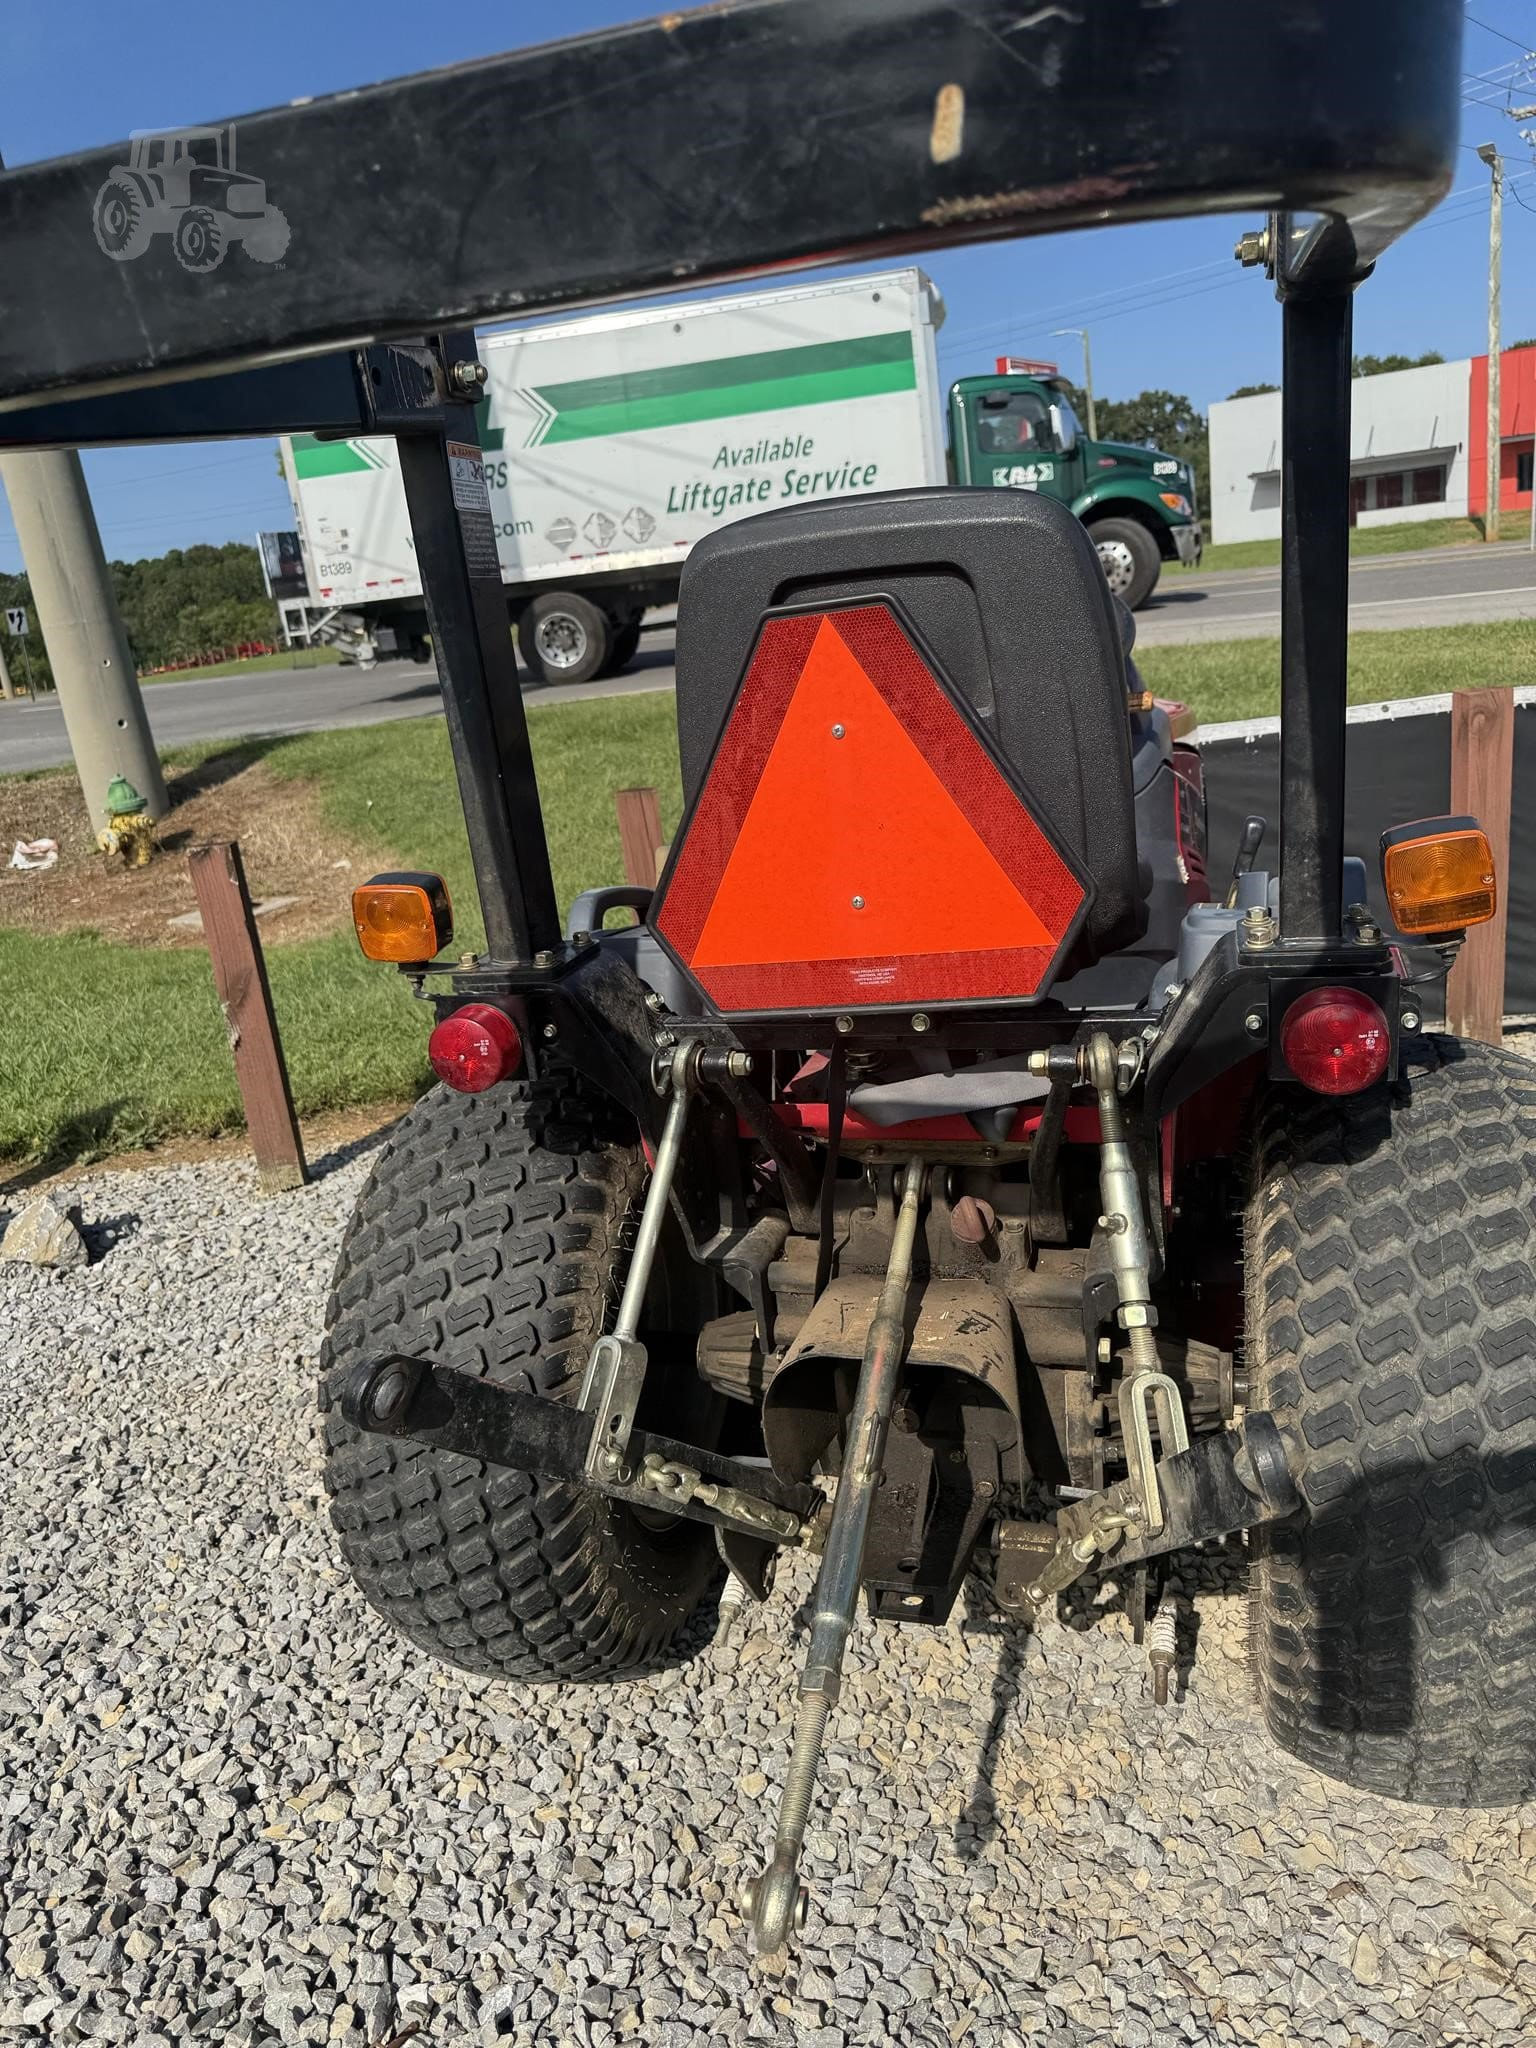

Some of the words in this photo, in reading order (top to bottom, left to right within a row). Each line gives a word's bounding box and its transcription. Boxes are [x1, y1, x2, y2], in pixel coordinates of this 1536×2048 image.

[712, 434, 813, 470] Available
[667, 478, 771, 517] Liftgate
[781, 461, 877, 498] Service
